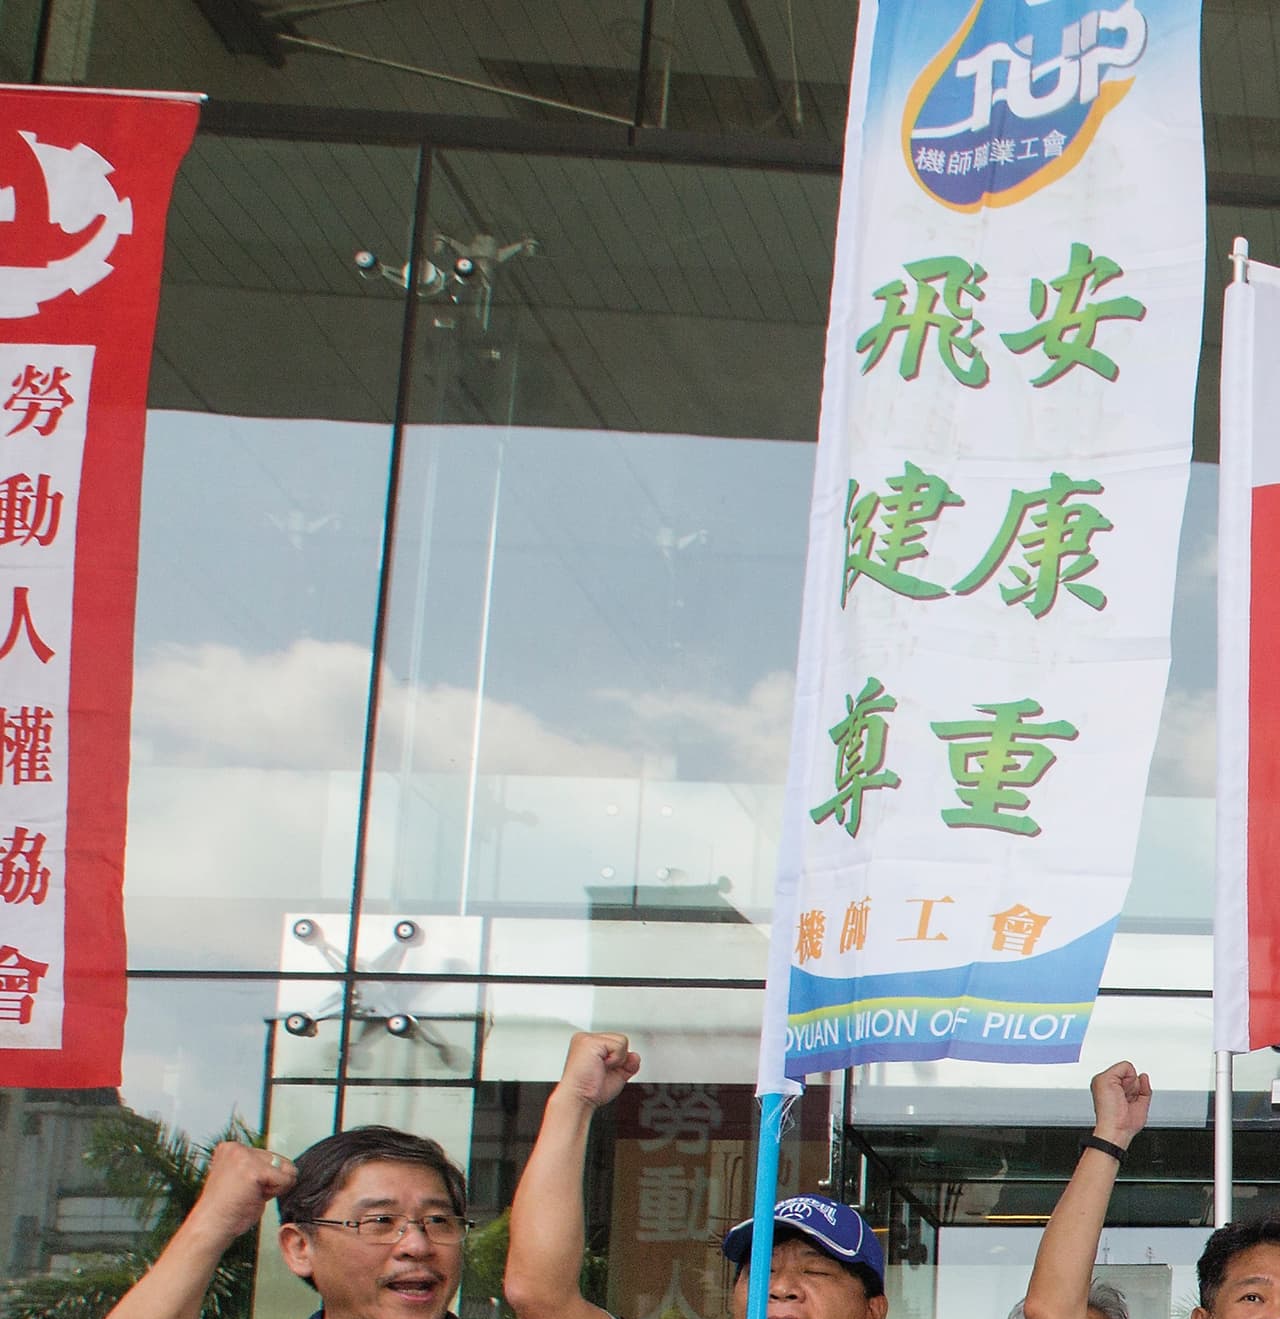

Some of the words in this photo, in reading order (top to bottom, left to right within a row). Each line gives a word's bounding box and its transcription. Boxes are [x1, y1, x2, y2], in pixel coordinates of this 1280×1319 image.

[914, 129, 1067, 175] 機師職業工會
[855, 243, 1147, 388] 飛安
[843, 461, 1113, 619] 健康
[0, 365, 73, 1025] 勞動人權協會
[810, 677, 1079, 837] 尊重
[795, 896, 1052, 964] 機師工會
[930, 1008, 970, 1036] OF
[982, 1014, 1077, 1040] PILOT
